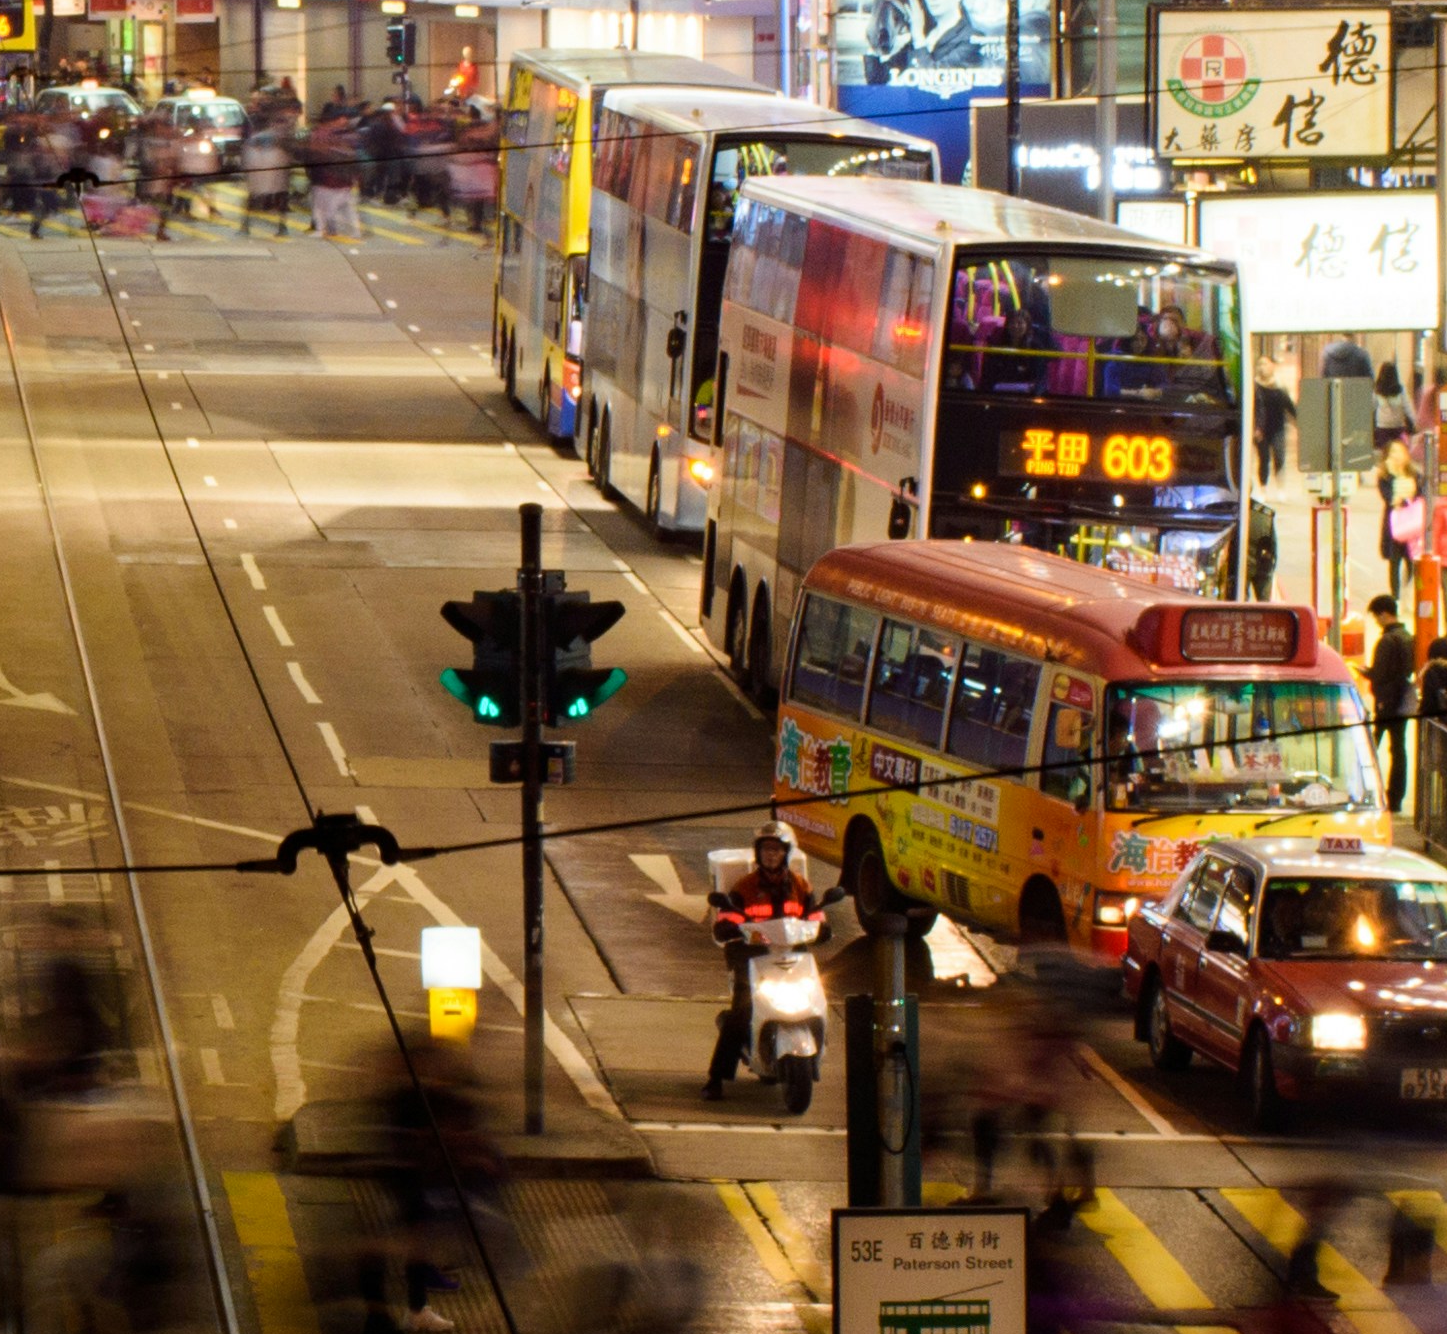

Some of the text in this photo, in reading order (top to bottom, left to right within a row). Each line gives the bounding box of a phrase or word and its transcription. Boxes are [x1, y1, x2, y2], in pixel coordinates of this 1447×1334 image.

[888, 66, 1005, 87] LONGINES
[1163, 122, 1256, 152] 大藥房
[1022, 429, 1174, 482] 平田 603
[1322, 837, 1363, 852] TAXI
[906, 1229, 1001, 1251] 百德新街
[851, 1240, 883, 1263] 53E
[893, 1256, 1014, 1271] Paterson Street
